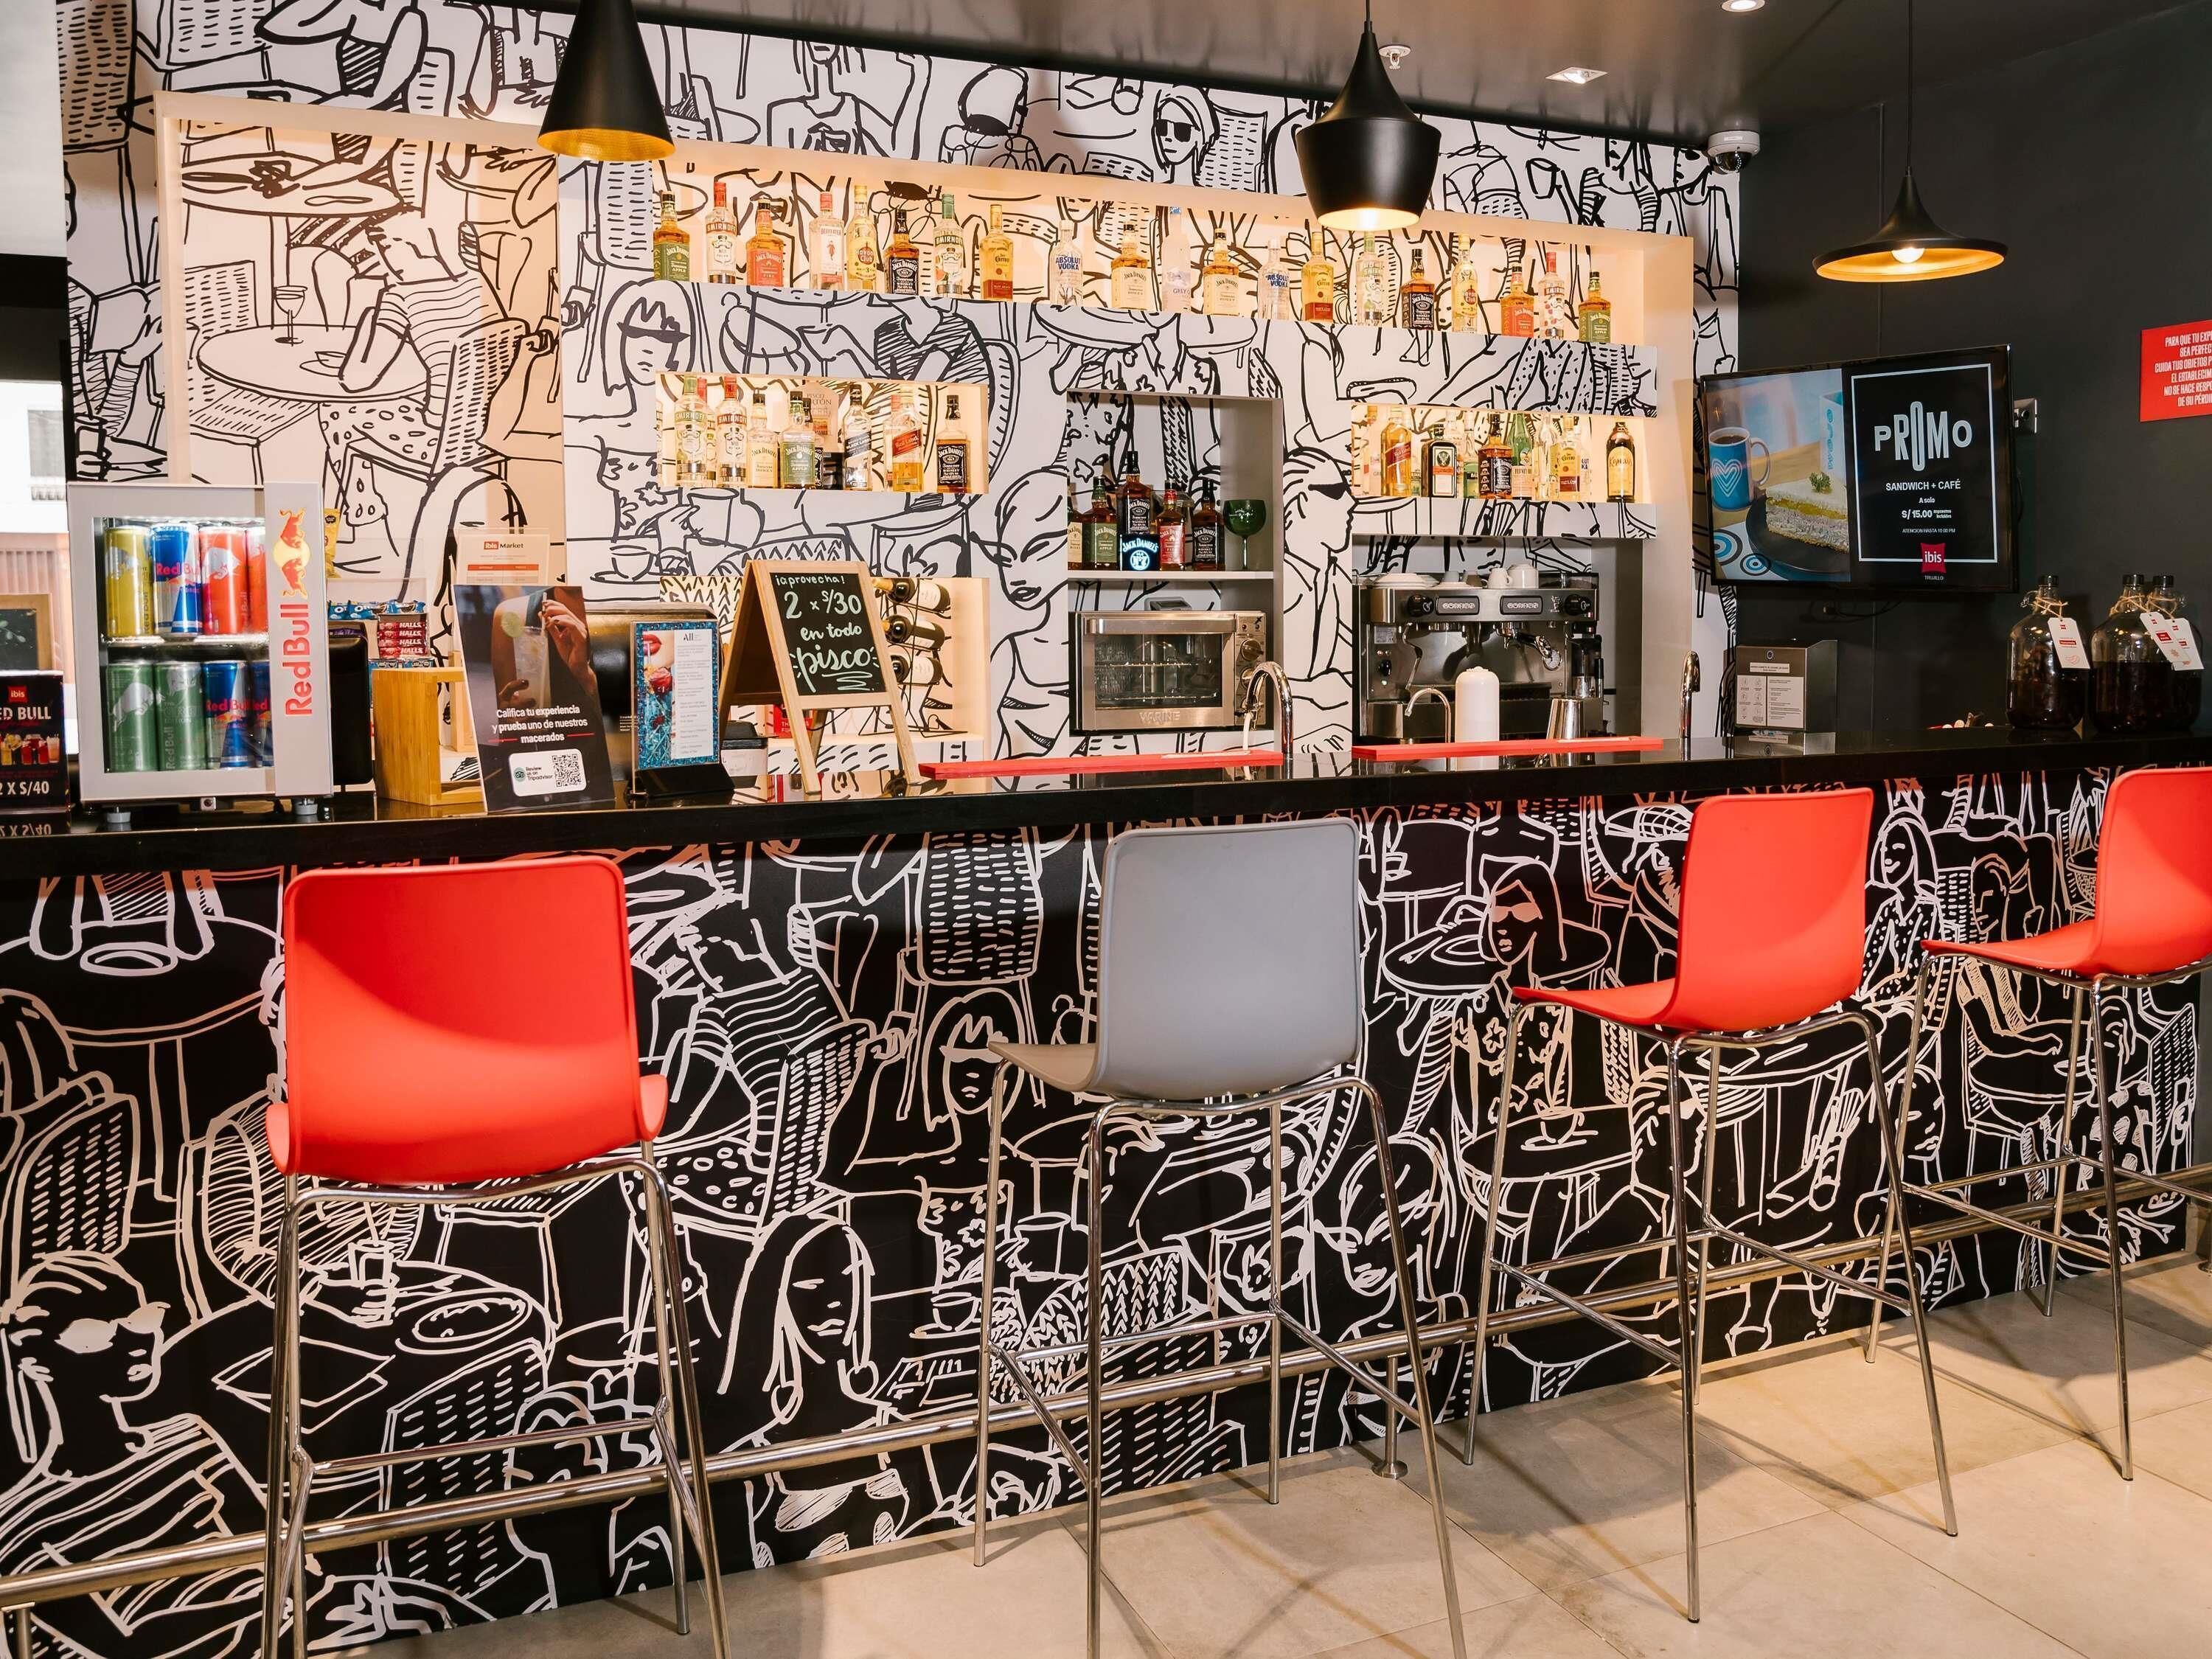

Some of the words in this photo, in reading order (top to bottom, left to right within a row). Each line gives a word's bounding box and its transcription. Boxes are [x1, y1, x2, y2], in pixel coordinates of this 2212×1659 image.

[2165, 336, 2180, 347] PARA
[2180, 334, 2192, 346] QUE
[2192, 333, 2199, 344] TU
[2180, 347, 2191, 358] SEA
[2154, 362, 2172, 373] CUIDA
[2172, 360, 2183, 371] TUS
[2171, 373, 2177, 383] EL
[2164, 386, 2172, 396] NO
[2173, 385, 2180, 395] SE
[2180, 383, 2195, 394] HACE
[2177, 397, 2185, 406] DE
[2186, 395, 2194, 406] SU
[1874, 400, 1972, 472] PROMO
[938, 448, 948, 457] JACK
[1885, 481, 1930, 491] SANDWICH
[1938, 479, 1961, 490] CAFÉ
[1122, 540, 1137, 552] JACK
[1136, 538, 1159, 553] DANIEL'S
[1924, 551, 1942, 563] ibis
[156, 562, 181, 576] Red
[784, 591, 802, 619] 2
[280, 604, 310, 655] Bull
[800, 626, 824, 641] en
[827, 622, 862, 638] todo
[796, 644, 872, 692] pisco
[282, 661, 313, 714] Red
[206, 698, 228, 711] Red
[252, 699, 268, 711] ed
[496, 708, 526, 718] Califica
[526, 709, 535, 717] tu
[535, 704, 580, 717] experiencia
[18, 706, 52, 720] BULL
[492, 725, 498, 734] y
[498, 721, 527, 734] prueba
[543, 720, 554, 728] de
[554, 718, 588, 728] nuestros
[521, 732, 565, 744] macerados
[7, 782, 16, 795] X
[20, 781, 50, 796] S/40
